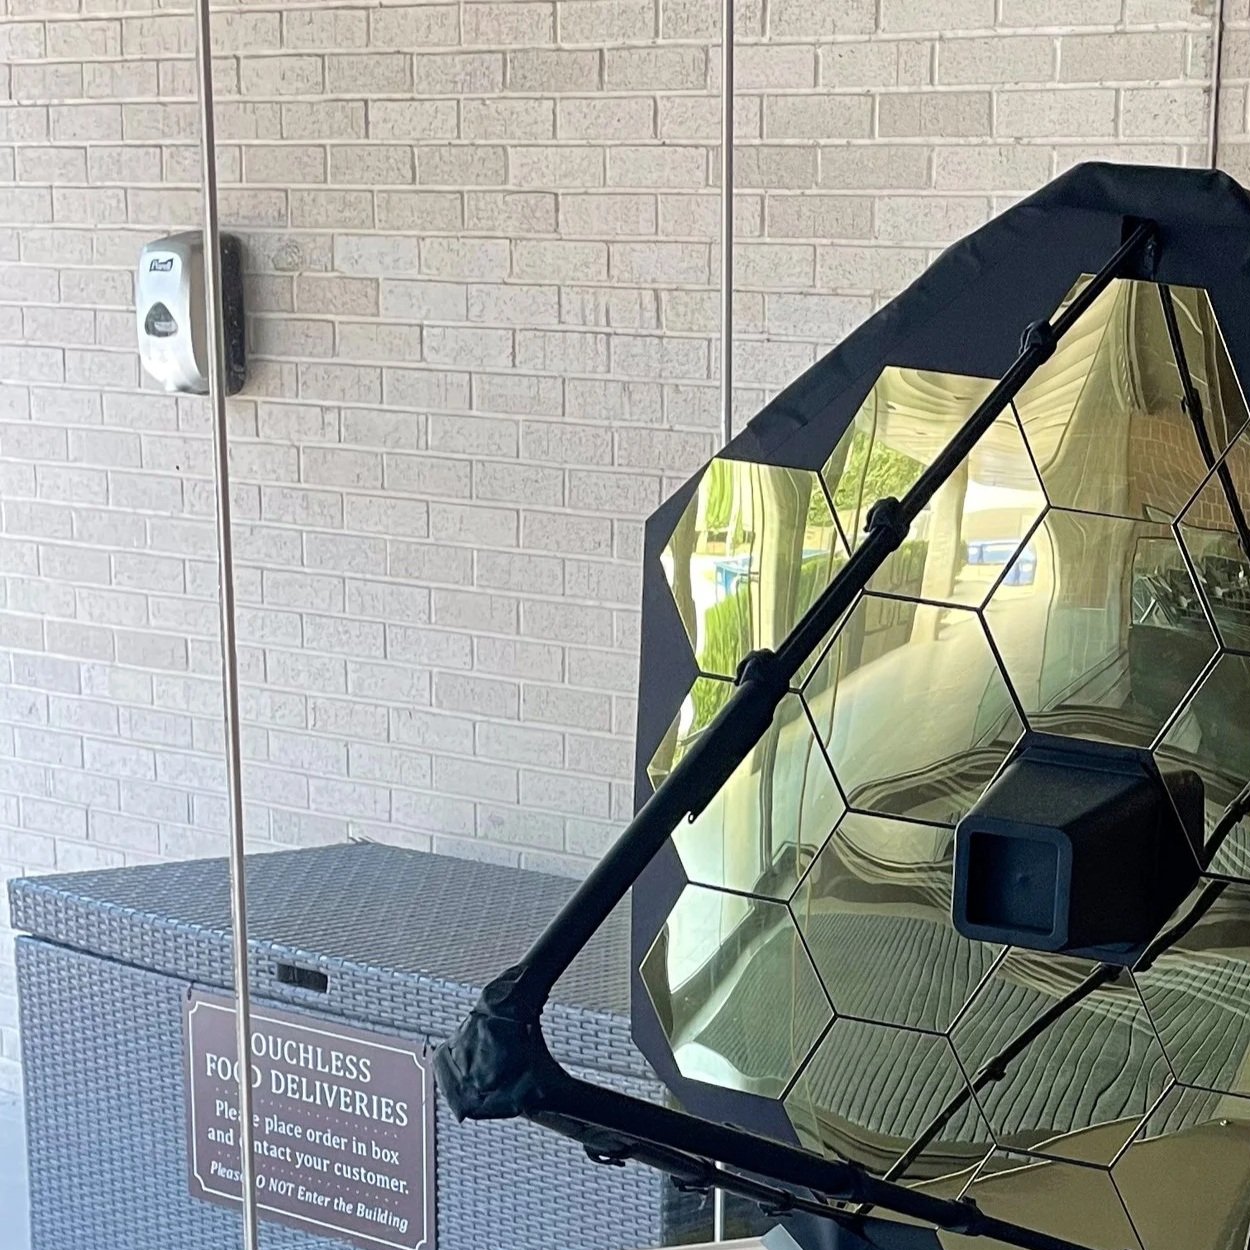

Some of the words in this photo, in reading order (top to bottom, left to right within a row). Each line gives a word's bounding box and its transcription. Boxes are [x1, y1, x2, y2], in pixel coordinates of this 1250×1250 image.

[251, 1032, 371, 1083] OUCHLESS
[271, 1069, 408, 1126] DELIVERIES
[215, 1099, 260, 1128] Plee
[264, 1114, 302, 1138] place
[306, 1128, 348, 1151] order
[352, 1136, 367, 1156] in
[371, 1140, 400, 1165] box
[207, 1127, 234, 1146] and
[239, 1137, 292, 1162] ntact
[295, 1151, 330, 1173] your
[334, 1162, 409, 1195] customer.
[269, 1177, 295, 1197] NOT
[297, 1185, 331, 1208] Enter
[333, 1197, 354, 1214] the
[356, 1202, 409, 1234] Building
